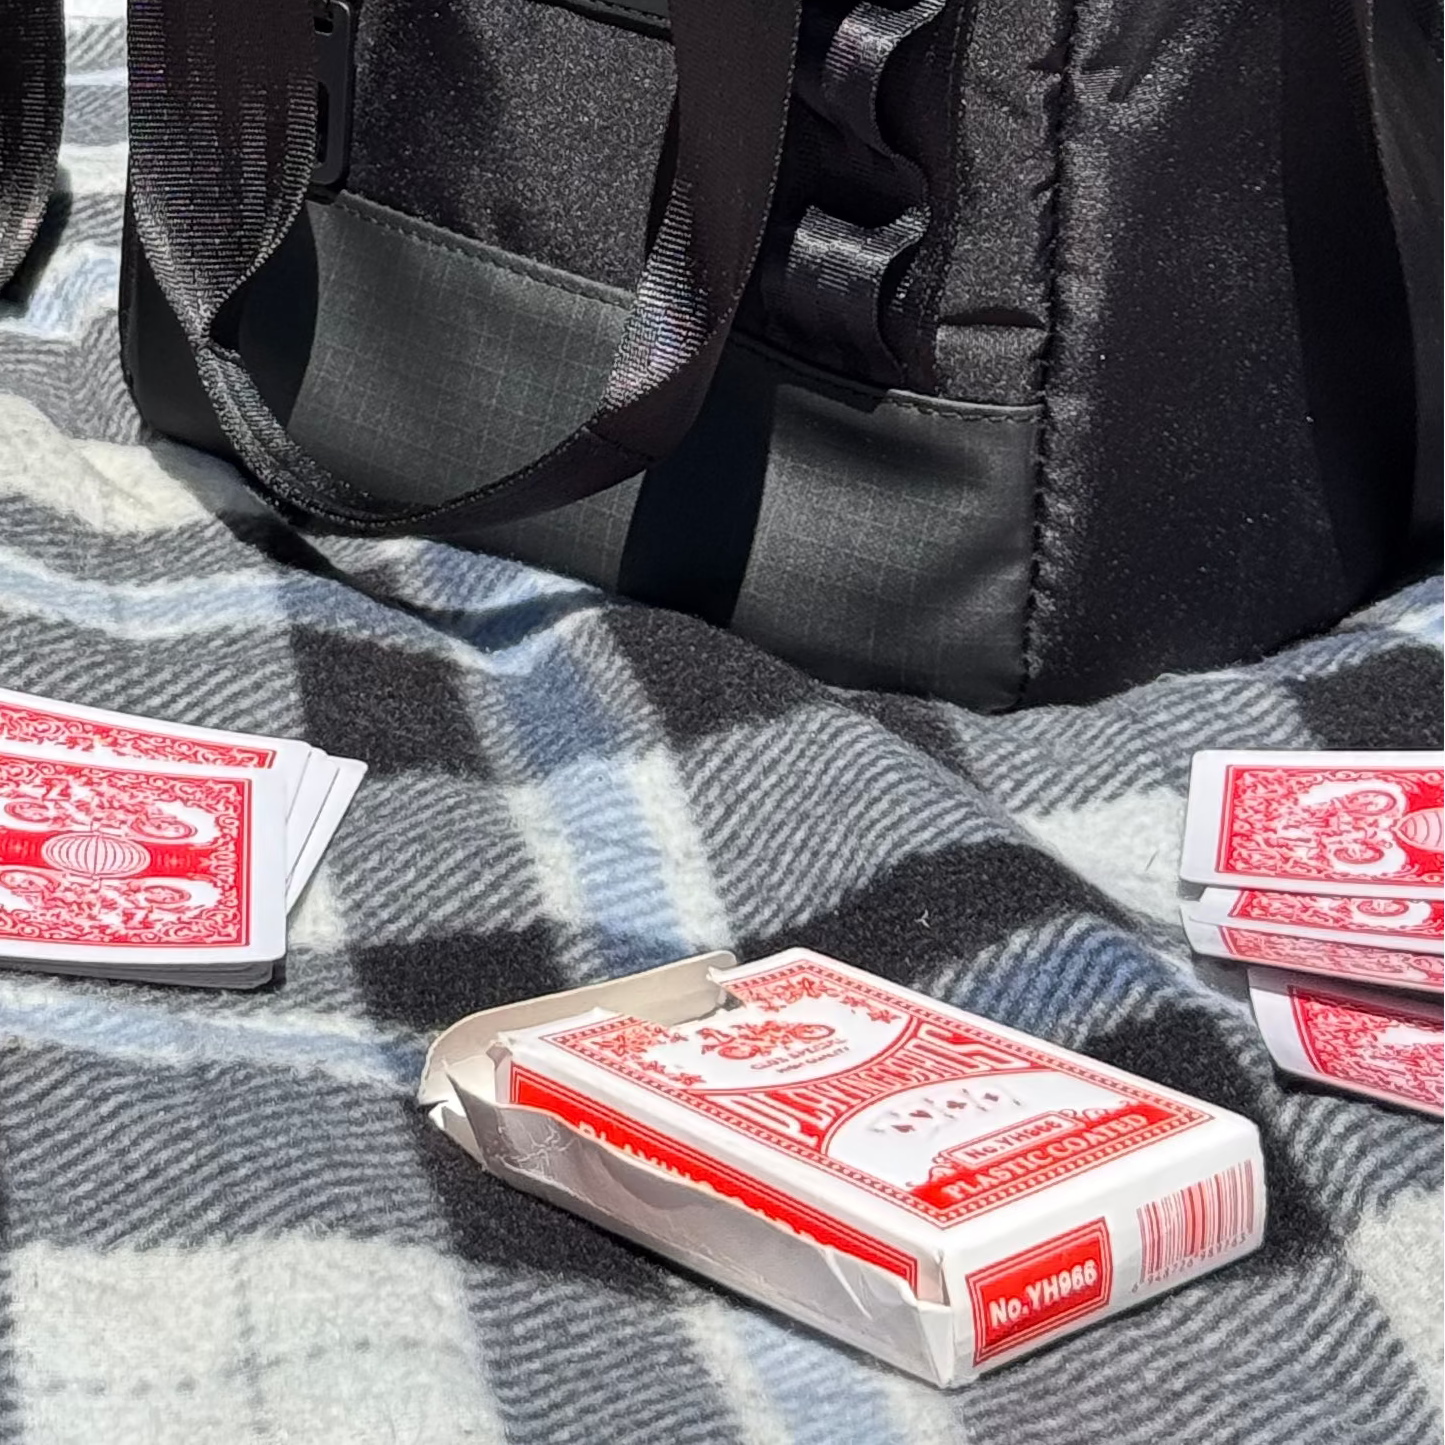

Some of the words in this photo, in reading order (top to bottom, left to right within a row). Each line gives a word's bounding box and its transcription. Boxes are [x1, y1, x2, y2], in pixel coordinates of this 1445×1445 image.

[940, 1149, 1054, 1200] PLASTIC
[1049, 1113, 1151, 1157] COATED
[989, 1259, 1098, 1328] No.YH966
